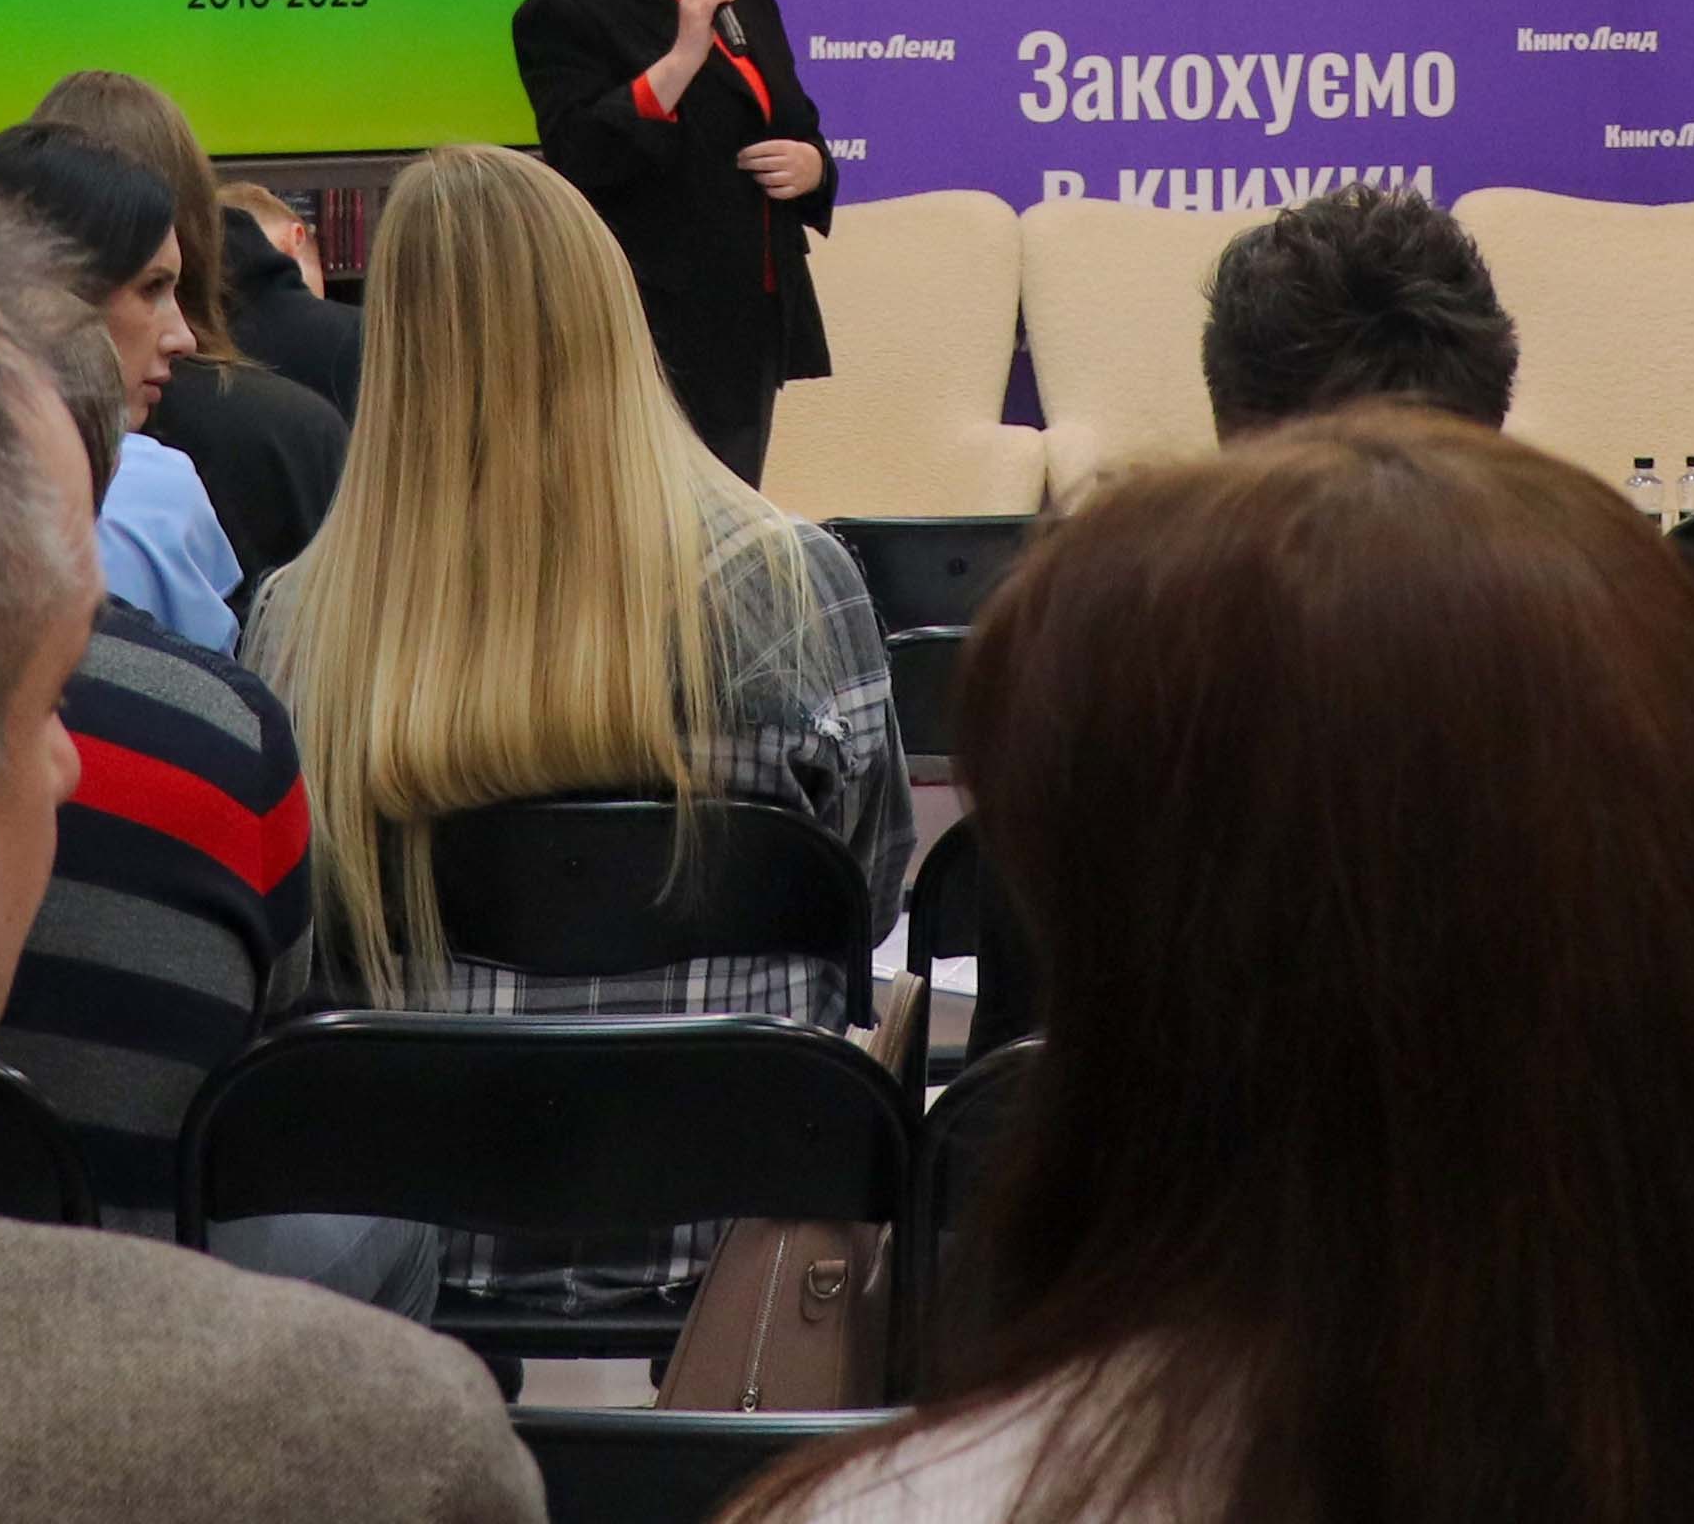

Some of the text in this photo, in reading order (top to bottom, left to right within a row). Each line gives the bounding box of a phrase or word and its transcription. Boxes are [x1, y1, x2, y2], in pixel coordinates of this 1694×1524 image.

[809, 34, 956, 61] КнигоЛенд
[1517, 26, 1658, 53] КнигоЛенд
[1018, 30, 1456, 136] Закохуємо
